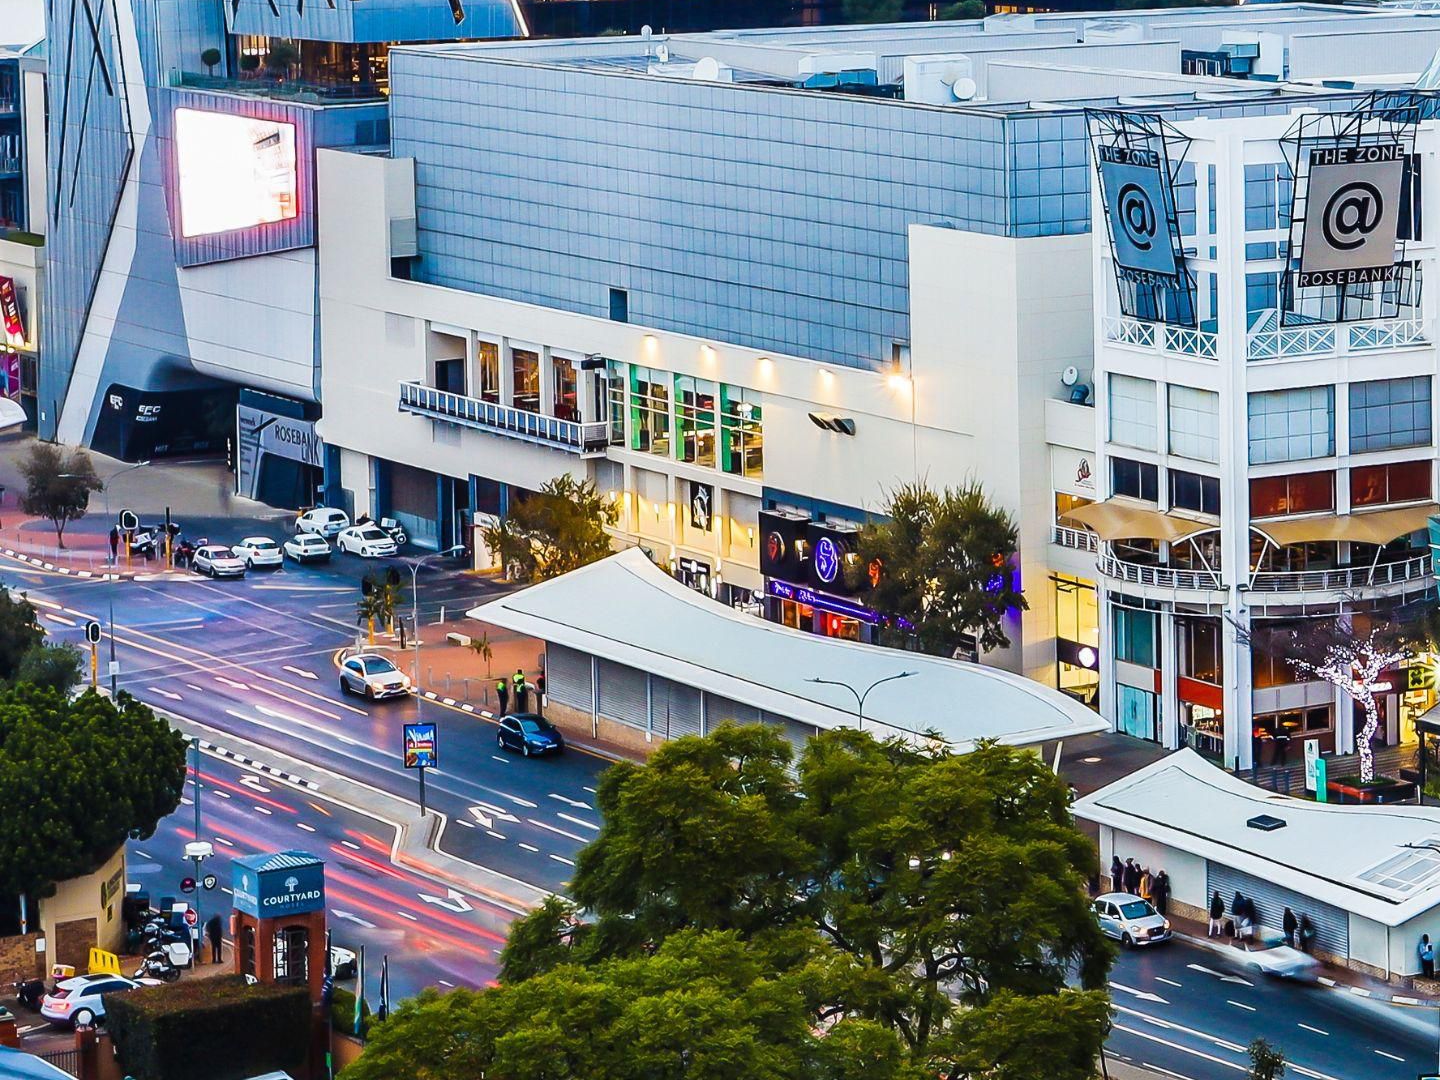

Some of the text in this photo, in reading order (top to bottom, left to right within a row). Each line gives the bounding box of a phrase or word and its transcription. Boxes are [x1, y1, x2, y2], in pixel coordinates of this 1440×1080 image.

[1100, 146, 1158, 167] THE ZONE
[1313, 145, 1405, 164] THE ZONE
[1118, 183, 1157, 251] @
[1322, 182, 1384, 251] @
[1120, 270, 1180, 290] ROSEBANK
[1300, 269, 1394, 286] ROSEBANK
[263, 890, 321, 906] COURTYARD
